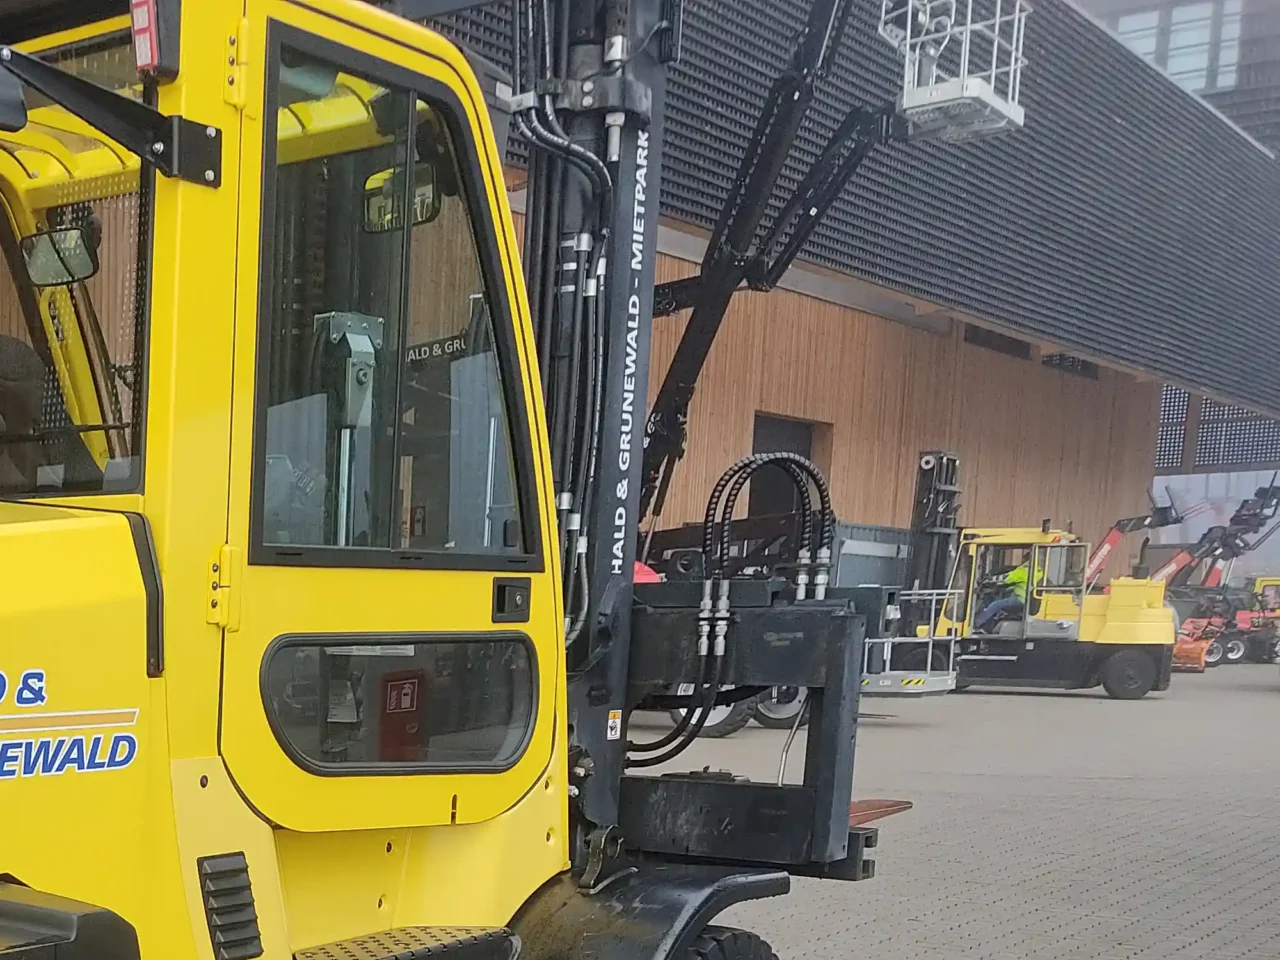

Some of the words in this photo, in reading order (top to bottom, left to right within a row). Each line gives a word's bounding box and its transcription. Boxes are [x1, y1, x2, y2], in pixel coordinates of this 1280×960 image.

[631, 129, 650, 270] MIETPARK
[433, 343, 443, 356] &
[618, 294, 640, 471] GRUNEWALD
[616, 477, 629, 500] &
[611, 506, 628, 574] HALD
[16, 669, 47, 706] &
